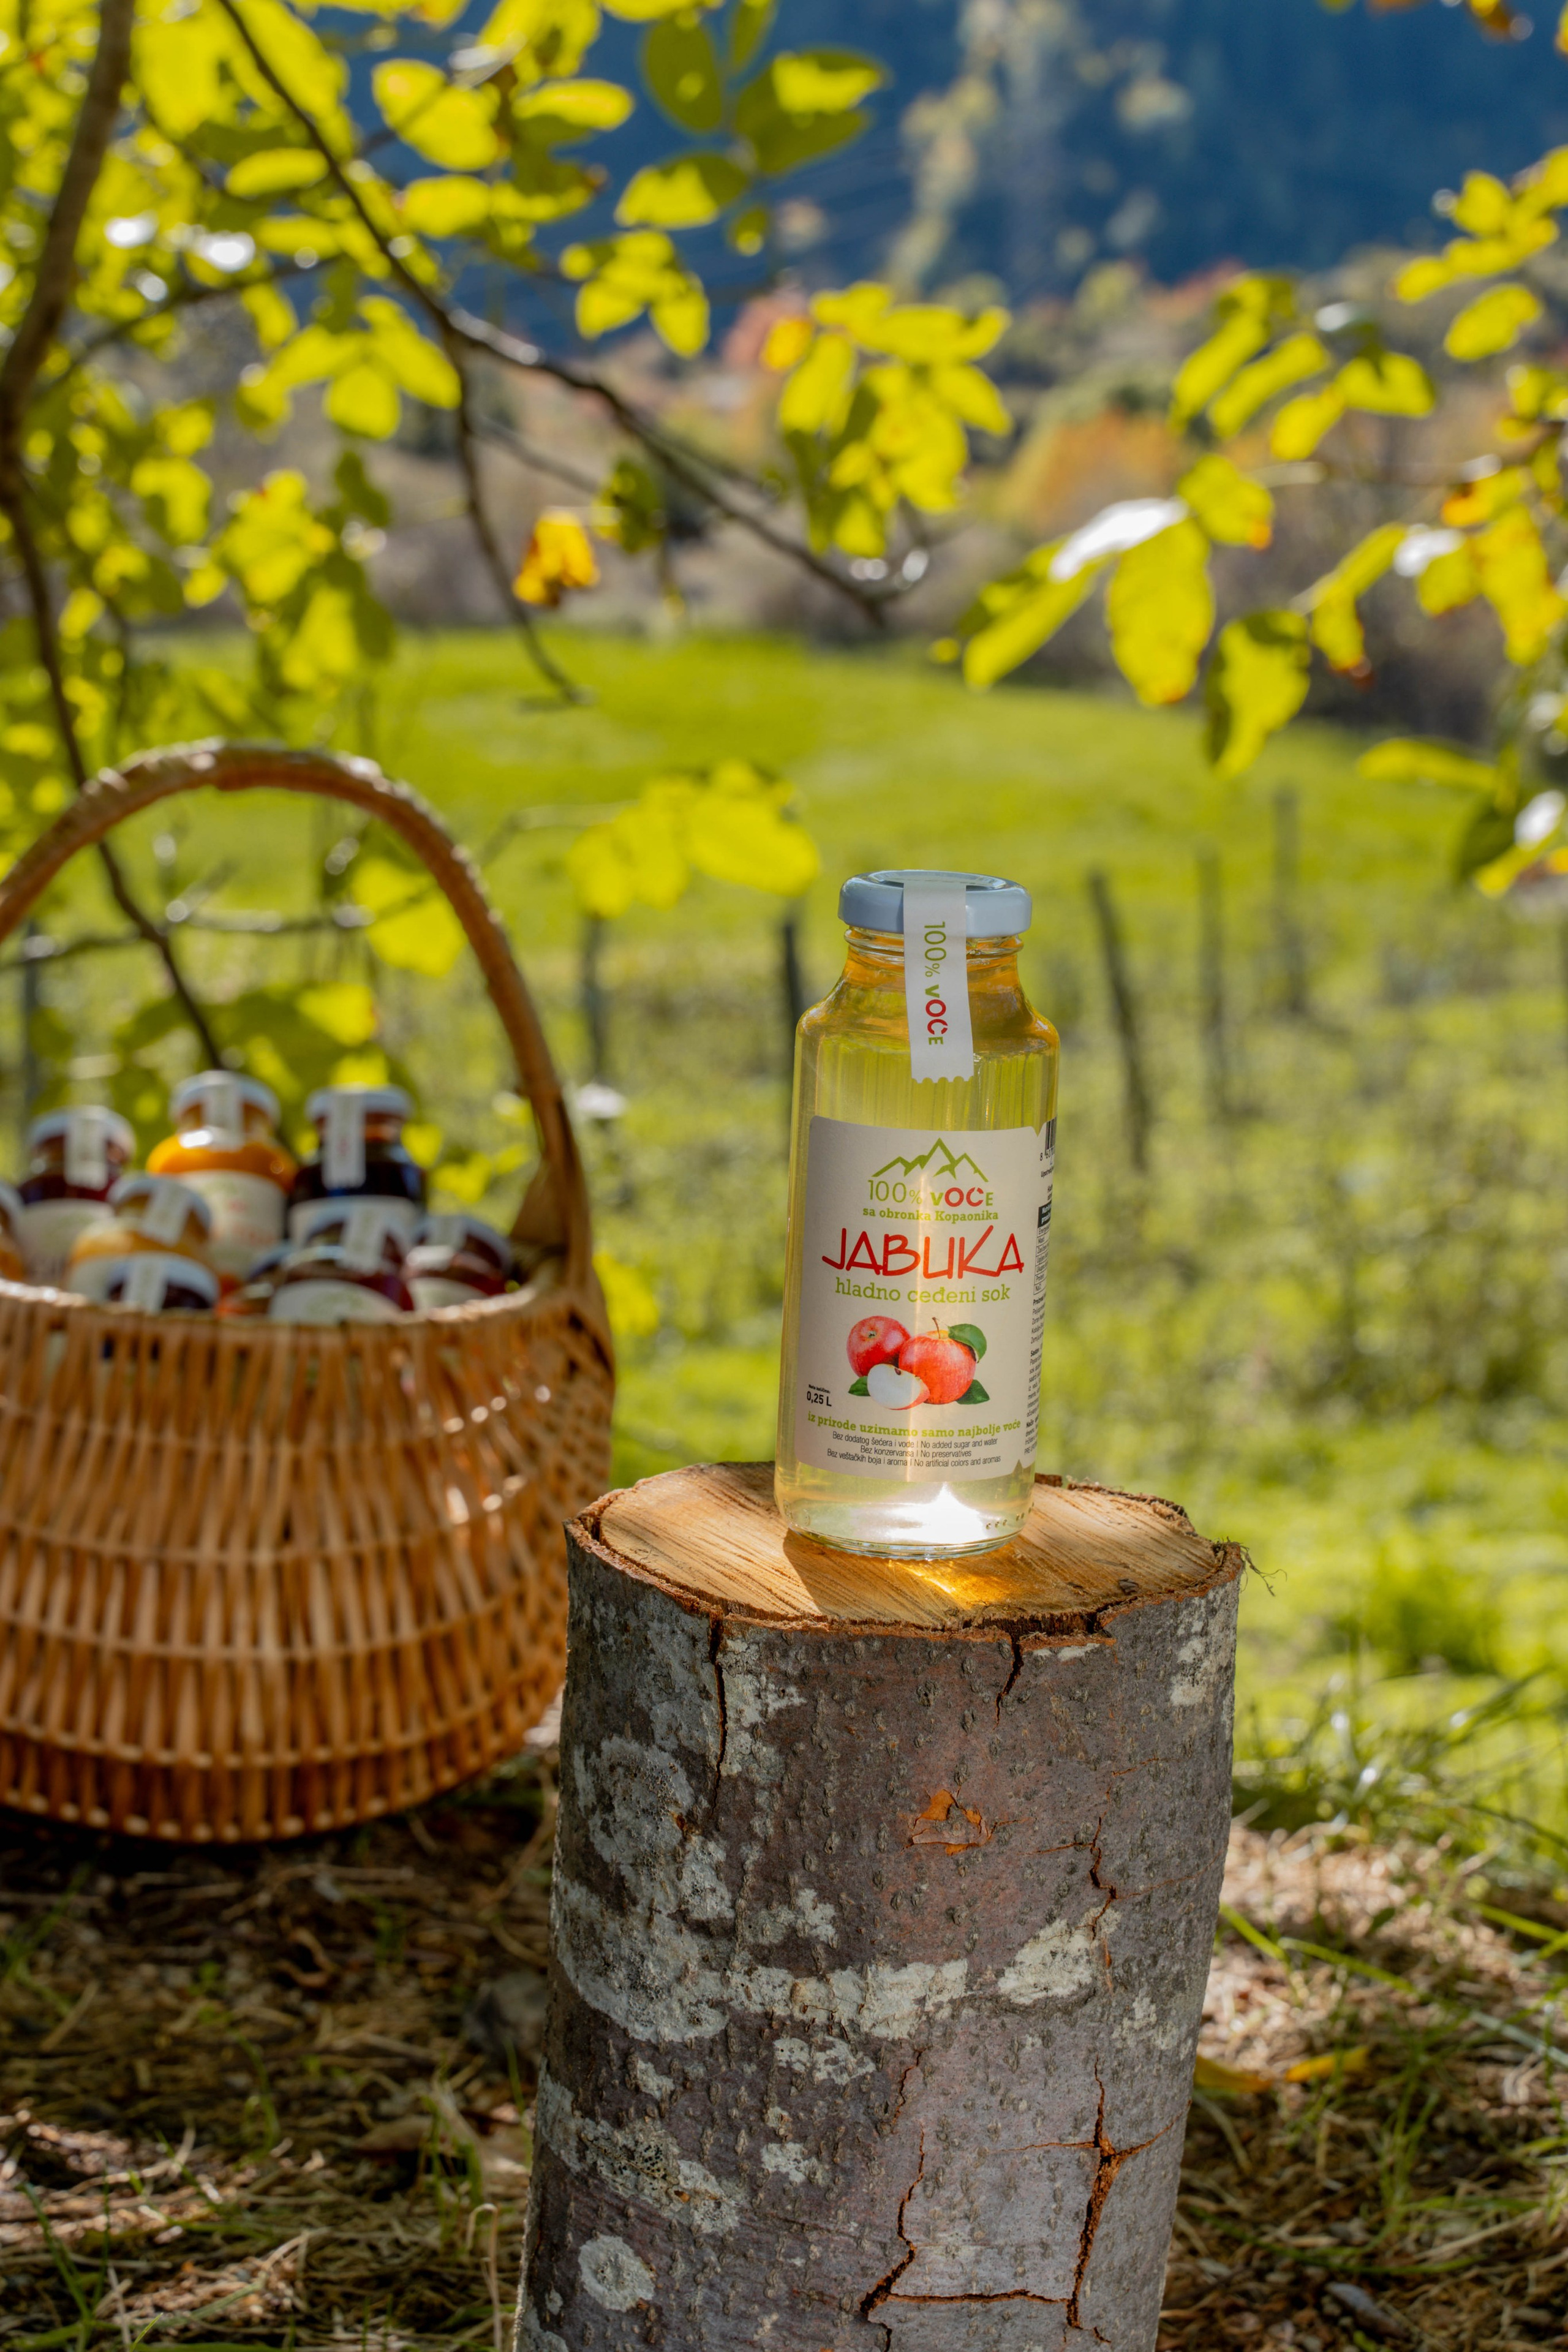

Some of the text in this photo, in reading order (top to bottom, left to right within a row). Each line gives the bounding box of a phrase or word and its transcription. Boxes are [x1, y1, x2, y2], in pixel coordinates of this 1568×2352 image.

[924, 921, 947, 978] 100%
[867, 1180, 923, 1205] 100%
[862, 1208, 999, 1224] sa obronka Kopaonika
[821, 1225, 1025, 1280] JABUKA
[834, 1277, 901, 1302] hladno
[981, 1283, 1011, 1302] sok
[807, 1390, 832, 1407] 0,25 L
[808, 1411, 815, 1422] iz
[817, 1415, 856, 1431] prirode
[859, 1424, 918, 1436] uzimamo
[921, 1429, 954, 1438] samo
[957, 1424, 1001, 1439] najbolje
[832, 1431, 843, 1440] Bez
[845, 1434, 870, 1446] dodatog
[871, 1438, 893, 1447] šećera
[954, 1441, 971, 1450] sugar
[827, 1448, 837, 1458] Bez
[839, 1451, 866, 1463] veštačkih
[868, 1456, 881, 1466] boja
[925, 1458, 949, 1467] artificial
[951, 1458, 969, 1467] colors
[982, 1455, 1001, 1465] aromas
[861, 1445, 872, 1454] Bez
[874, 1447, 914, 1457] konzervansa
[932, 1450, 972, 1459] preservatives
